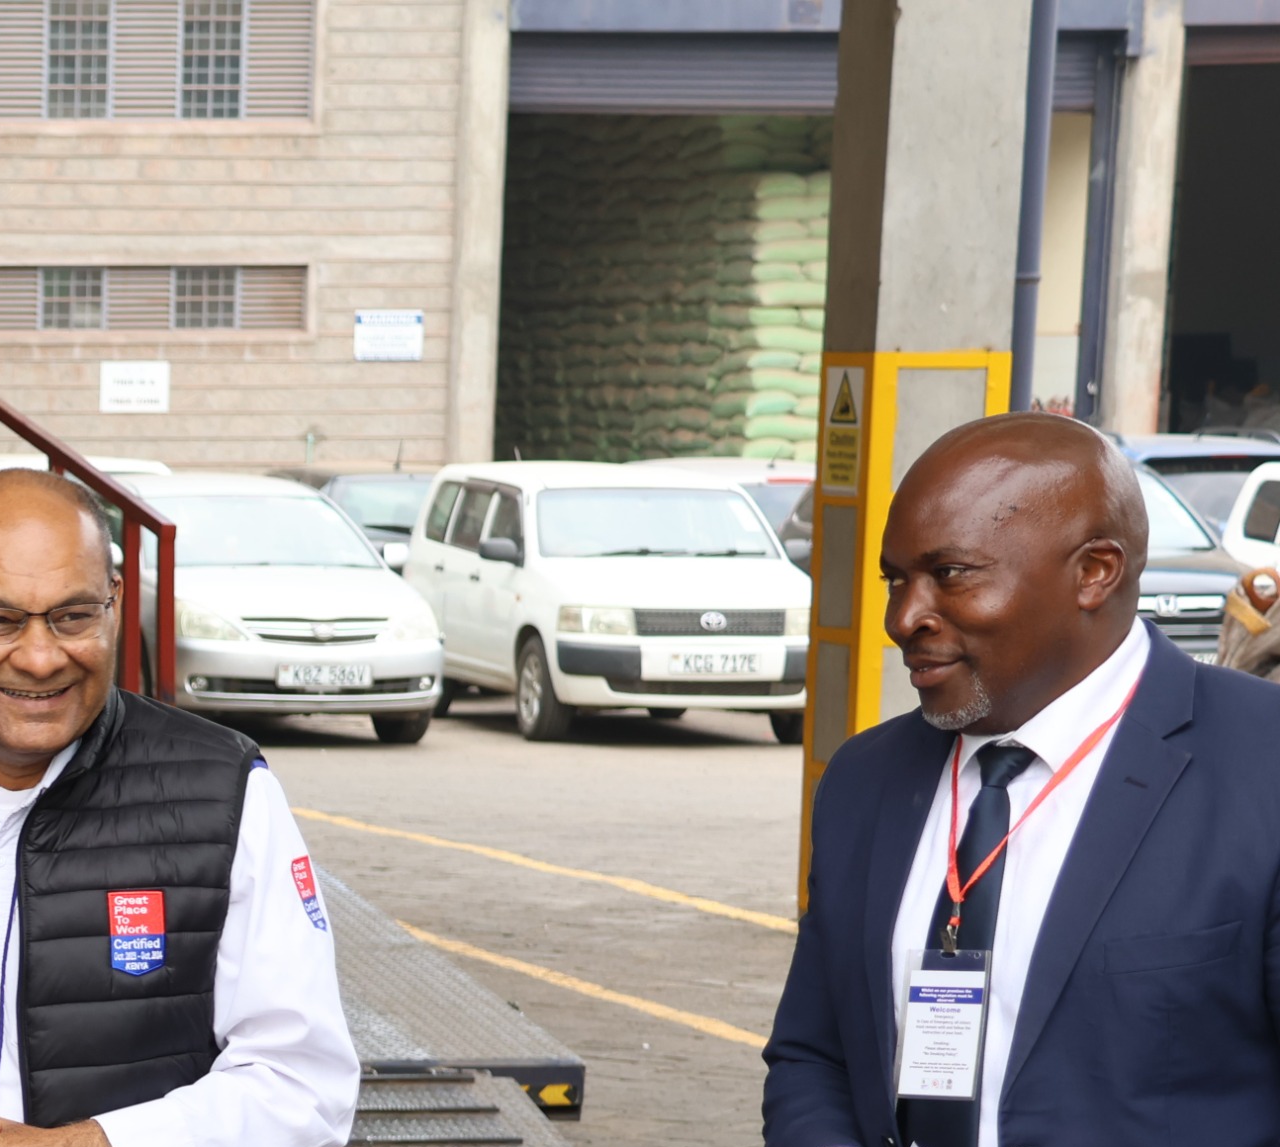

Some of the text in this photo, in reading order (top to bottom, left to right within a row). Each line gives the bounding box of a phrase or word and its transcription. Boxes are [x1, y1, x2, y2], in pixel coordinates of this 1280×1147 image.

[683, 654, 756, 673] KCG 717E
[114, 896, 149, 905] Great
[114, 906, 148, 915] Place
[115, 916, 130, 924] To
[116, 925, 149, 934] Work
[114, 938, 160, 949] Certified
[125, 962, 149, 970] KENYA
